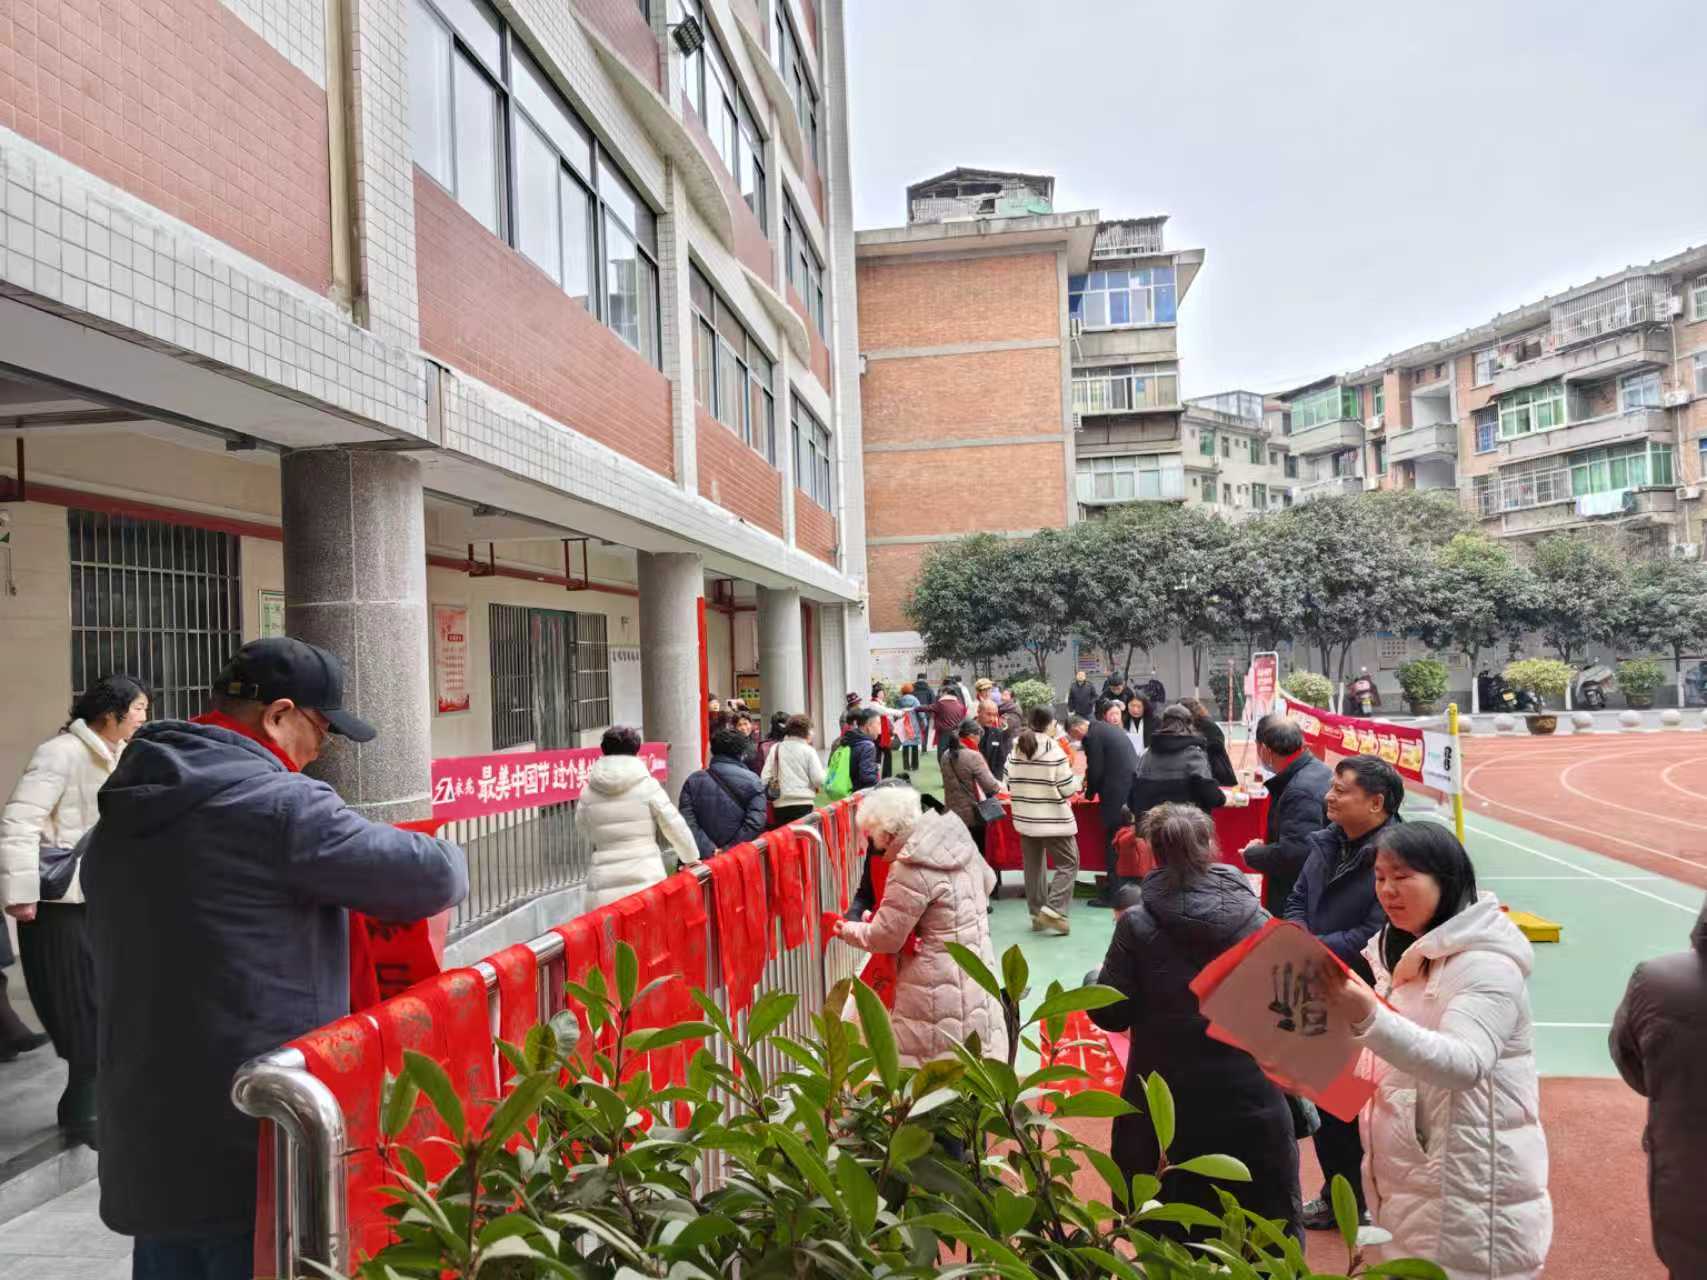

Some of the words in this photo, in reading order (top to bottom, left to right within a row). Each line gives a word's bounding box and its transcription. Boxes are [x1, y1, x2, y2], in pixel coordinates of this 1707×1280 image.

[478, 760, 550, 804] 最美中国节
